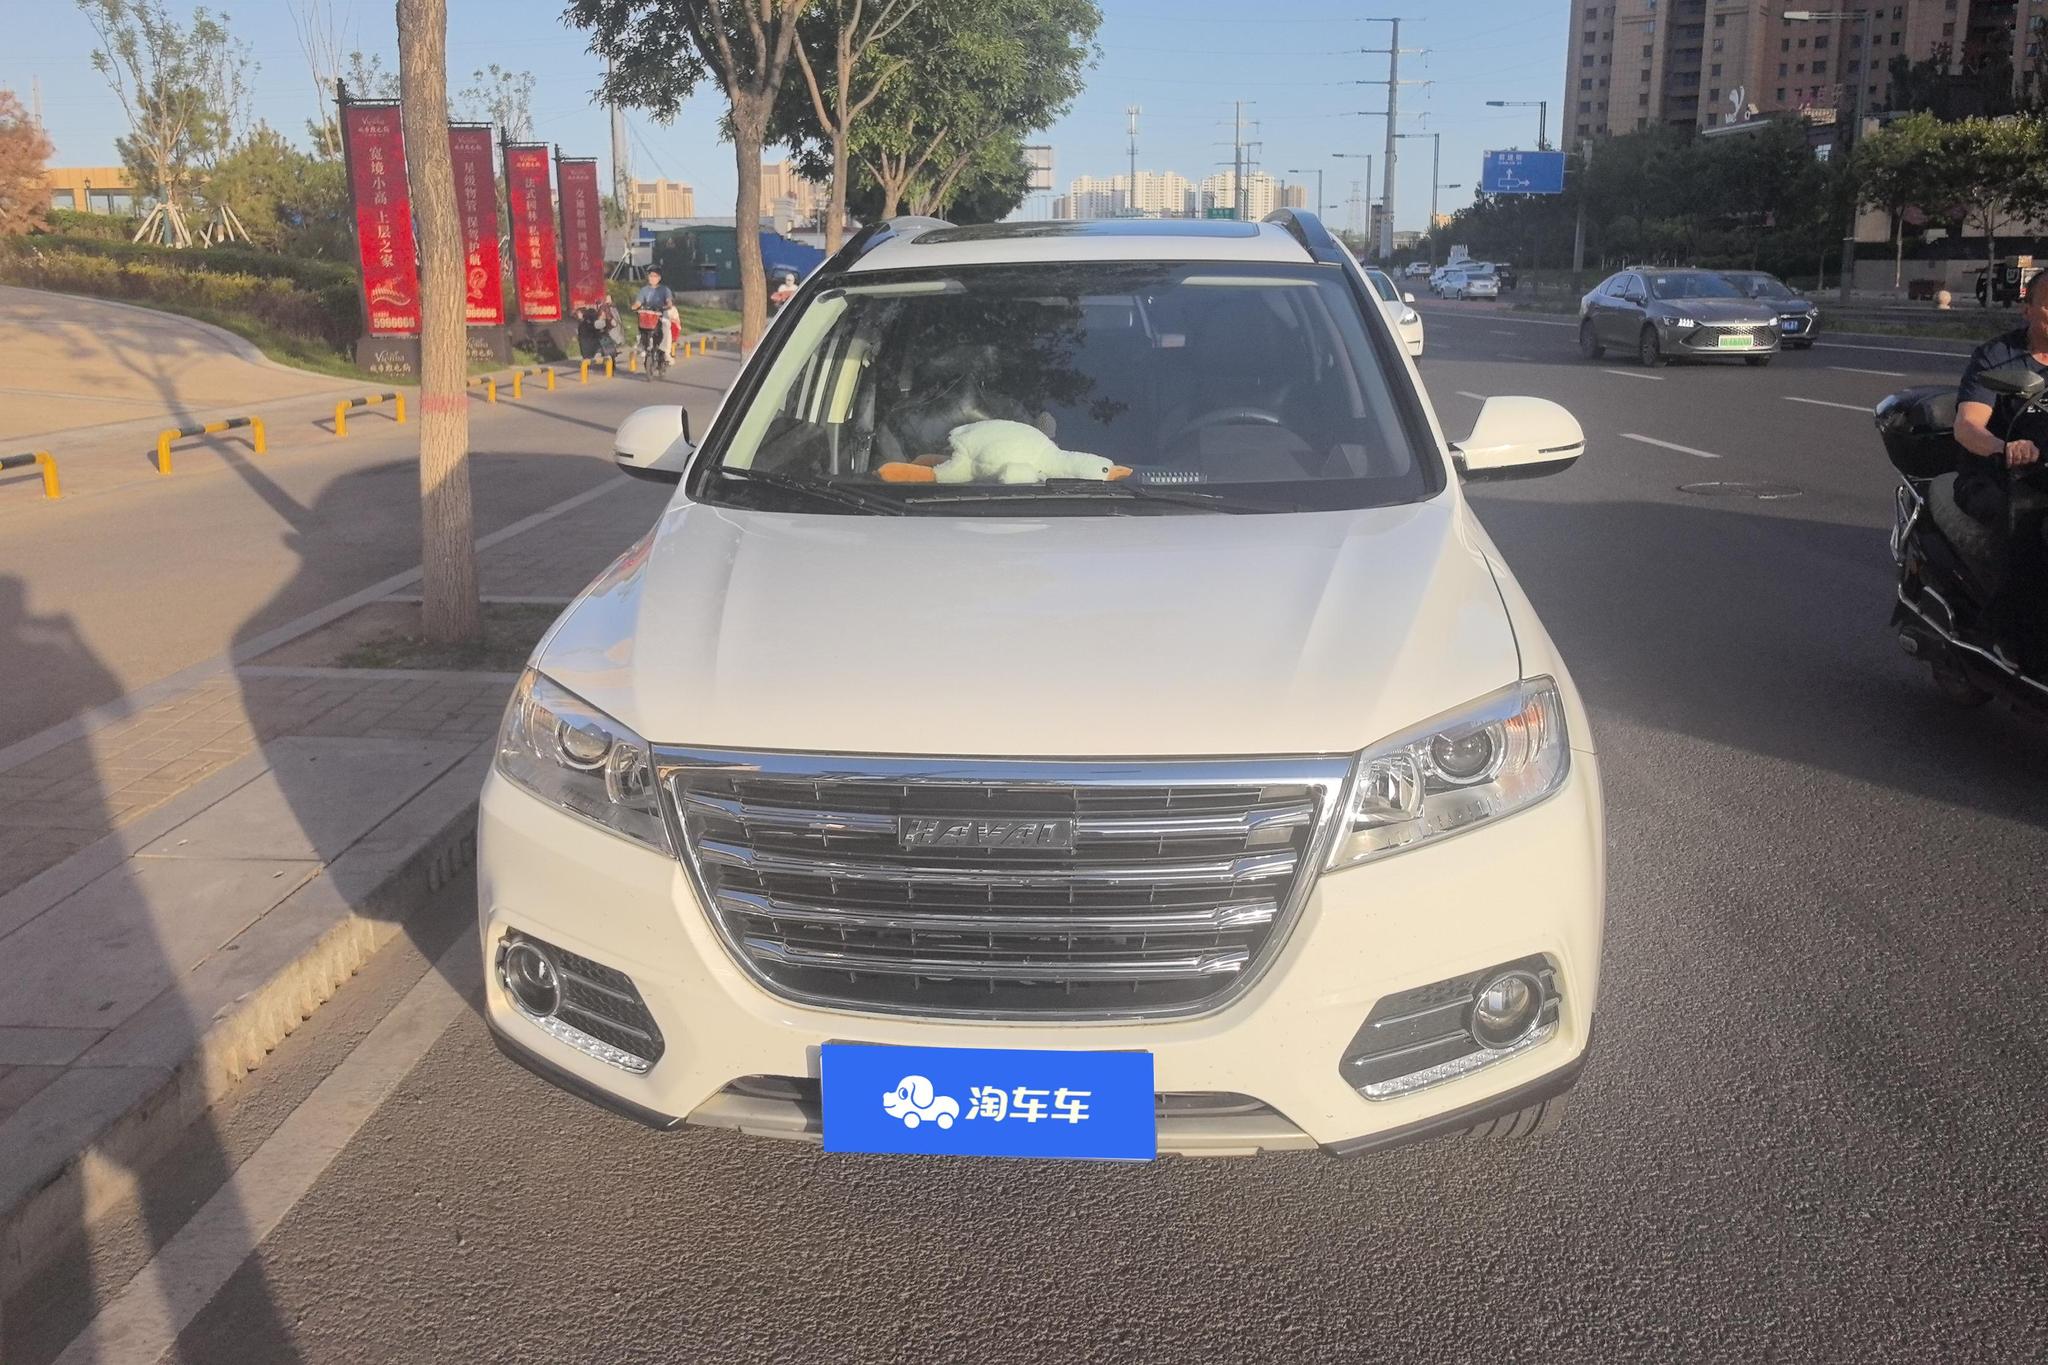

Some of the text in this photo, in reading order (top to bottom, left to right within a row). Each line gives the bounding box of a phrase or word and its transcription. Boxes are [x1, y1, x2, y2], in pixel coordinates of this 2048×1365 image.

[377, 211, 395, 268] 上层之家
[903, 818, 1067, 846] HAVAL
